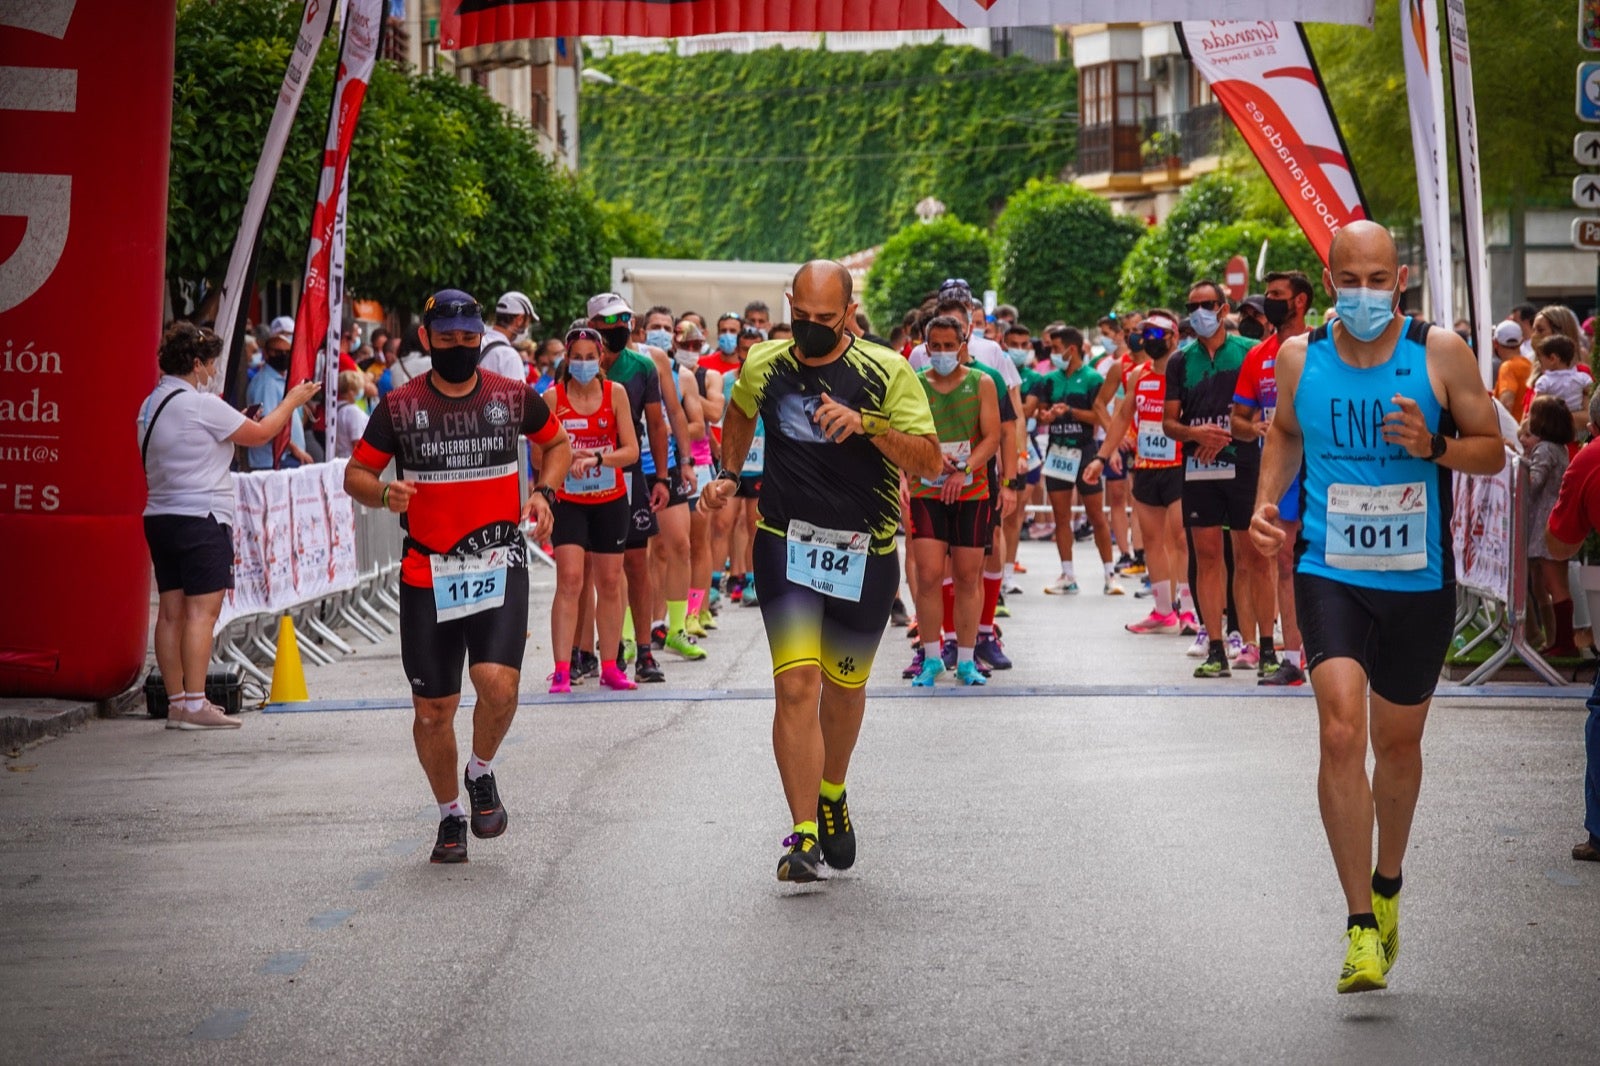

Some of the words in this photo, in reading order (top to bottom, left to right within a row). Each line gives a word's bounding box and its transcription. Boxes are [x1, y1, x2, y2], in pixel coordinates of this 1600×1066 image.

[0, 339, 63, 374] ión
[443, 410, 479, 437] CEM
[421, 440, 439, 457] CEM
[439, 438, 470, 455] SIERRA
[471, 436, 504, 451] BLANCA
[1145, 435, 1168, 448] 140
[0, 445, 59, 463] nt@s
[446, 453, 483, 468] MARBELLA
[1343, 524, 1409, 549] 1011
[806, 548, 850, 576] 184
[448, 577, 496, 601] 1125
[810, 579, 834, 593] ALVARO
